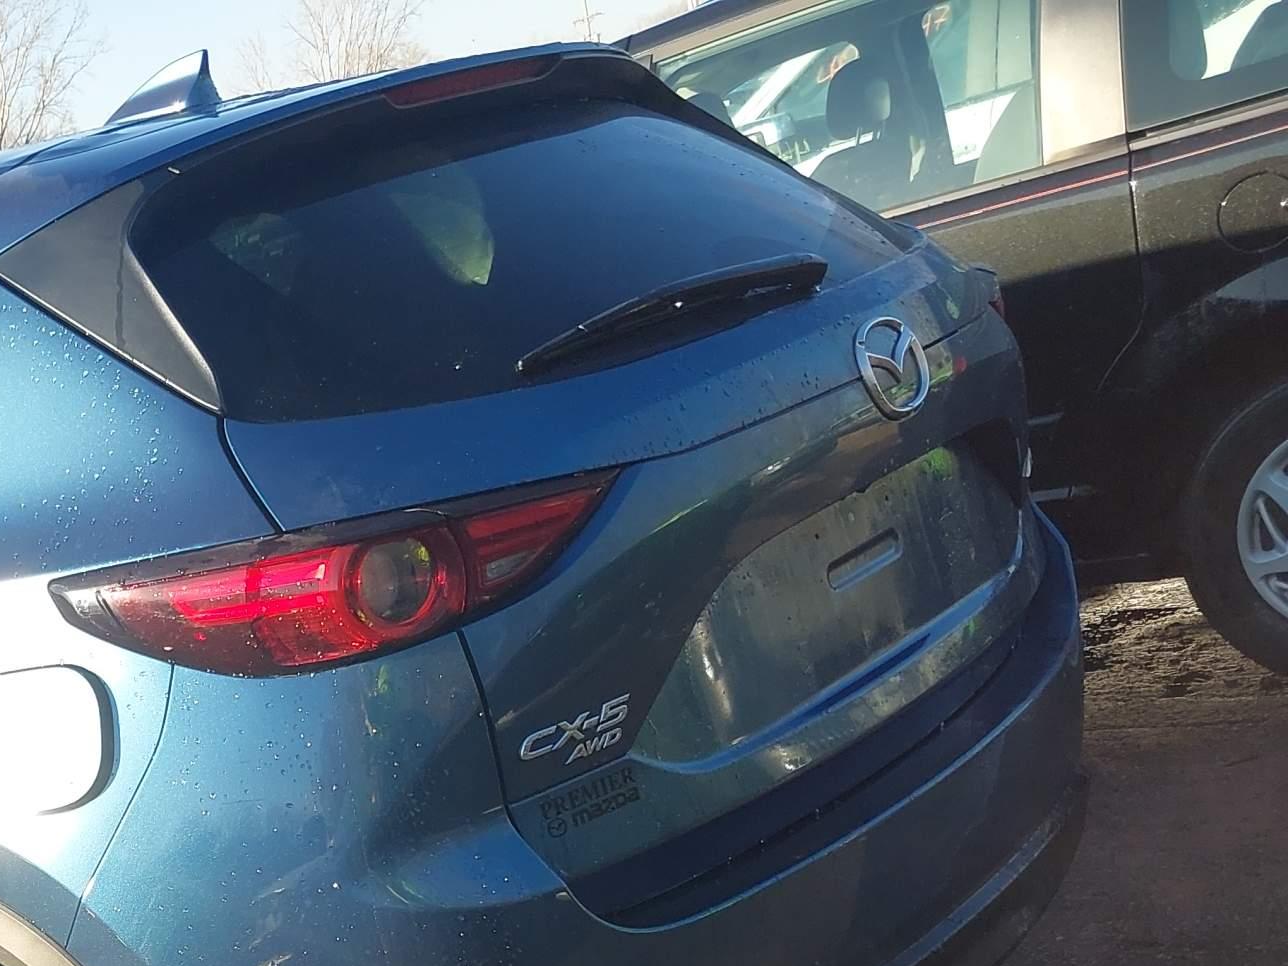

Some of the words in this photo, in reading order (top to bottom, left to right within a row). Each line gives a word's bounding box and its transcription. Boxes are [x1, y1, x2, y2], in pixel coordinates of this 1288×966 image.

[520, 693, 630, 760] CX-5
[565, 727, 623, 765] AWD
[539, 766, 636, 820] PREMIER
